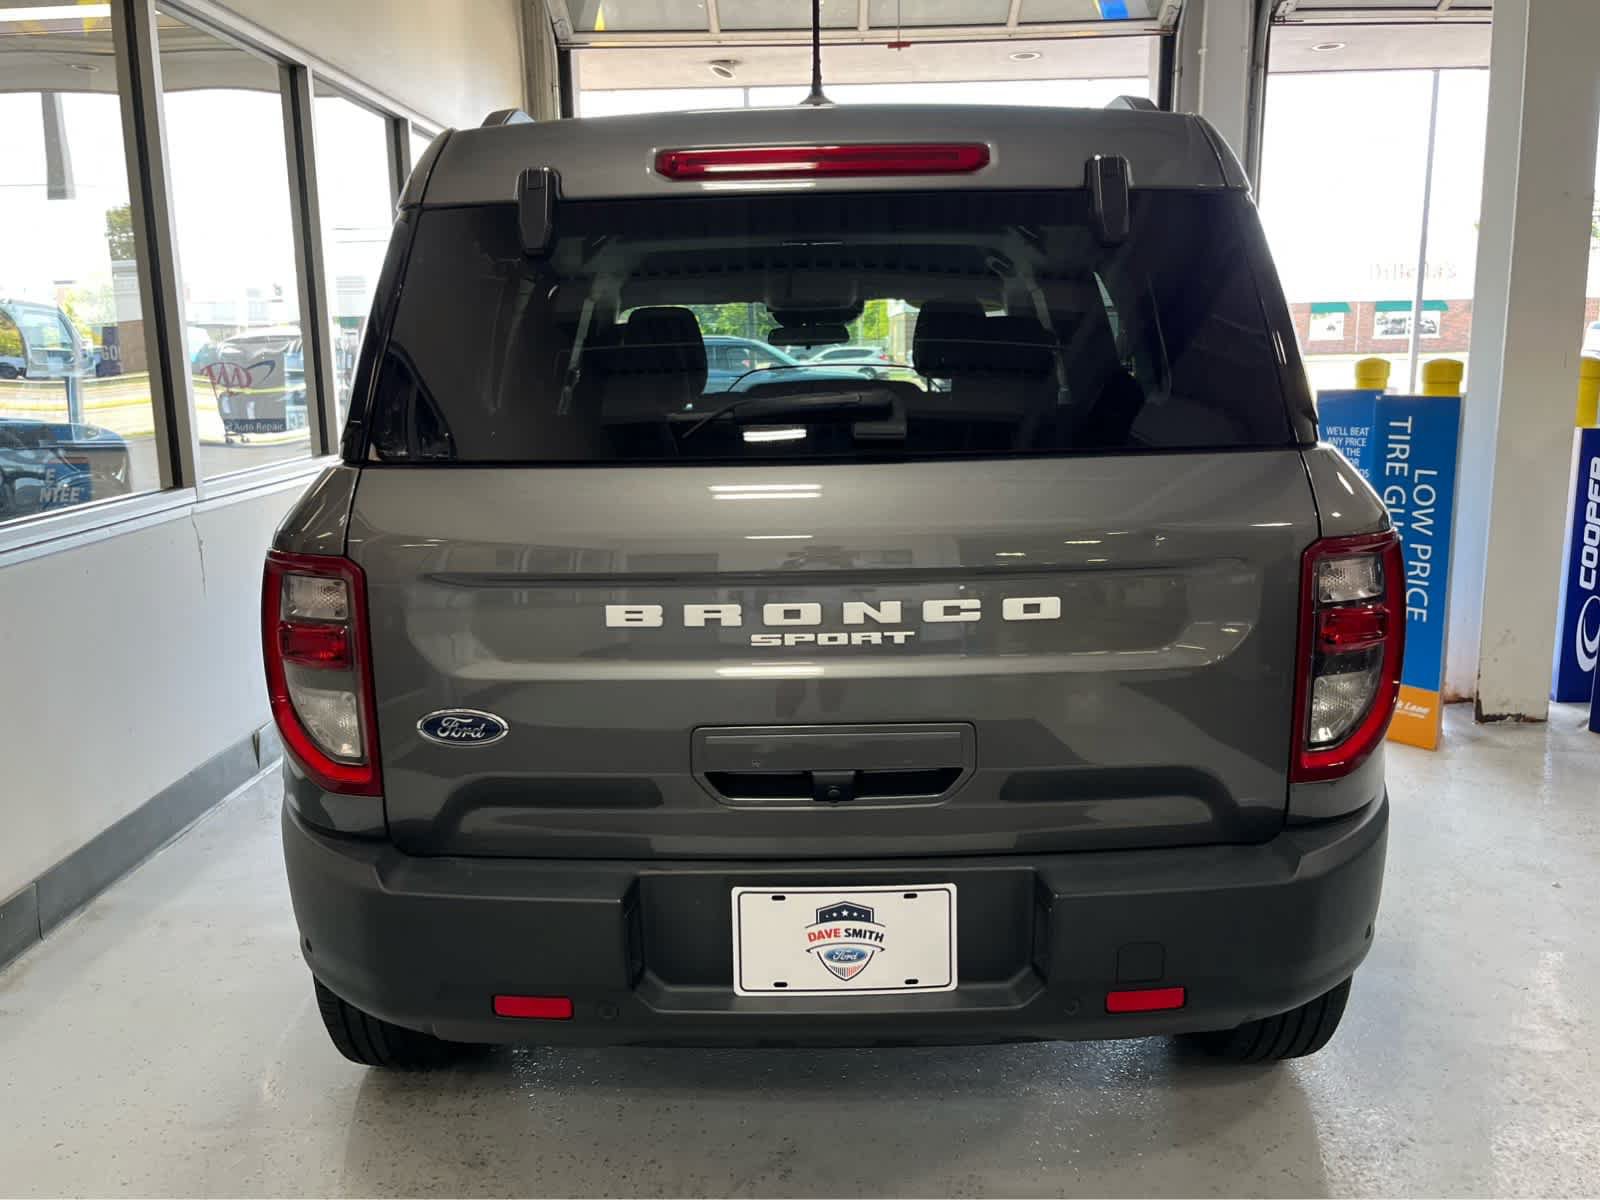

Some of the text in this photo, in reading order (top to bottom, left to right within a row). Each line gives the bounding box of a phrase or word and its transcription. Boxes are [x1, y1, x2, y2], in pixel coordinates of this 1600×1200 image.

[234, 422, 254, 431] Auto
[256, 421, 283, 431] Repair
[1326, 426, 1370, 437] WE'LL BEAT
[1328, 436, 1367, 447] ANY PRICE
[1385, 416, 1412, 477] TIRE
[1346, 447, 1361, 457] THE
[1406, 469, 1437, 624] LOW PRICE
[605, 596, 1061, 628] BRONCO
[750, 631, 915, 647] SPORT
[436, 716, 487, 738] Ford
[807, 927, 884, 943] DAVE SMITH
[832, 951, 859, 961] Ford
